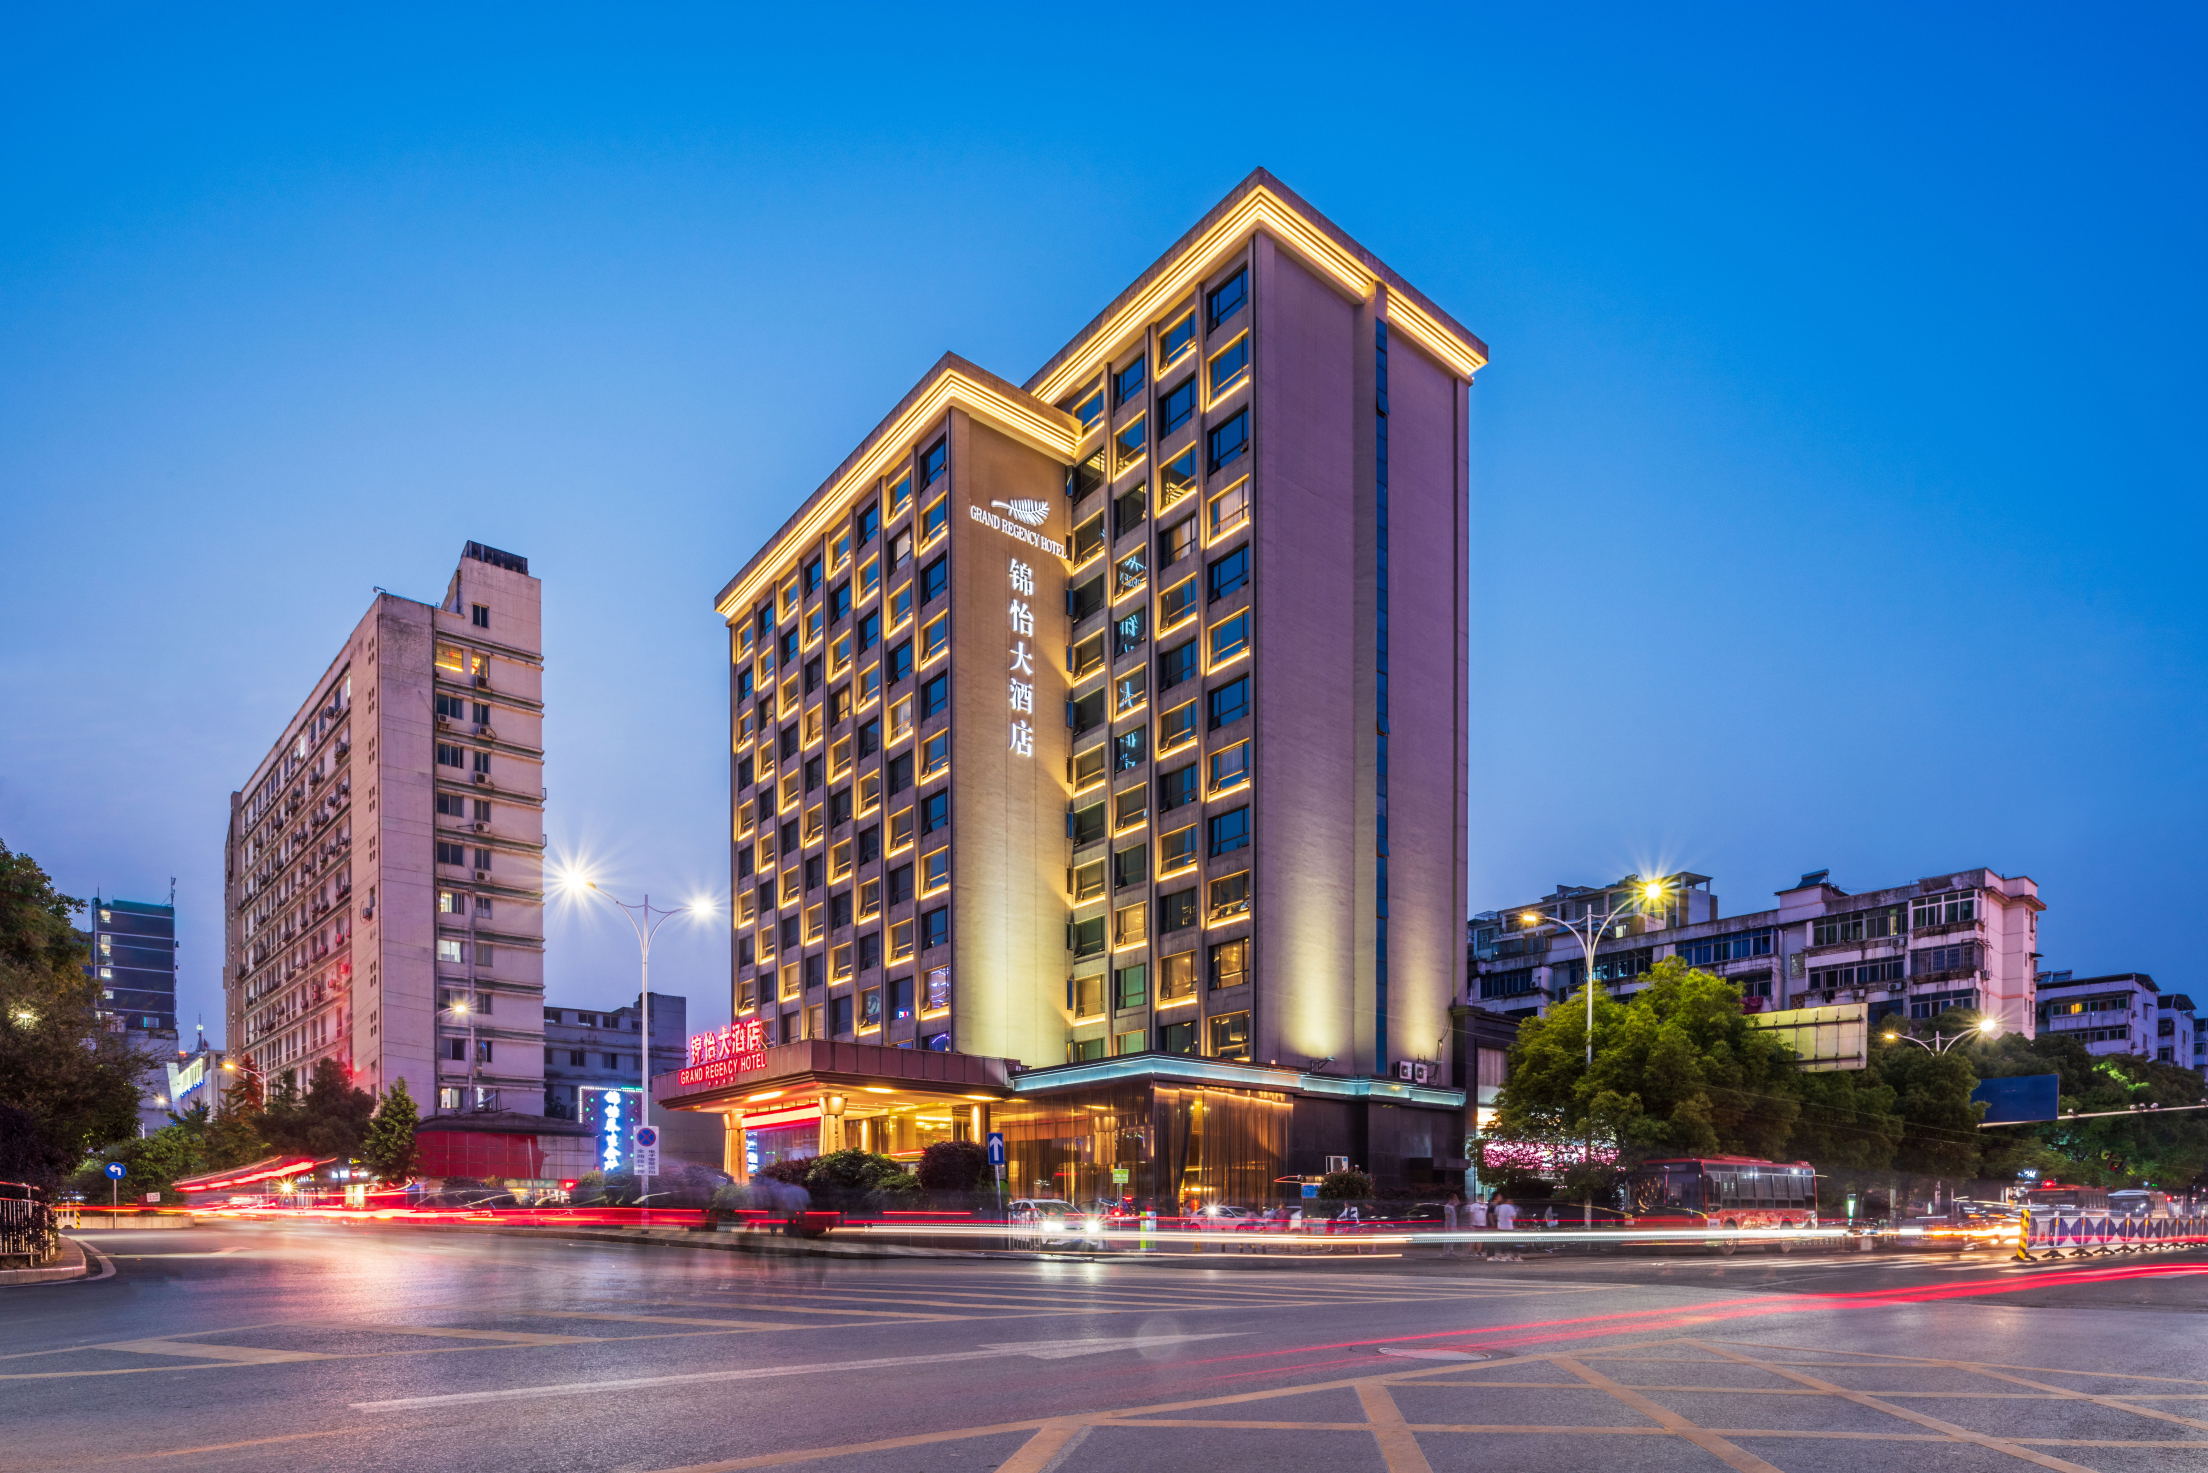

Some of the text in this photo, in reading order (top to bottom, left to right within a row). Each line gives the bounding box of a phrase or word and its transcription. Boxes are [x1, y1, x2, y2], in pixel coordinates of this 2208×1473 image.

[970, 505, 1068, 559] GRAND REGENCY HOTEL
[1009, 558, 1035, 758] 锦怡大酒店
[680, 1053, 767, 1085] GRAND REGENCY HOTEL
